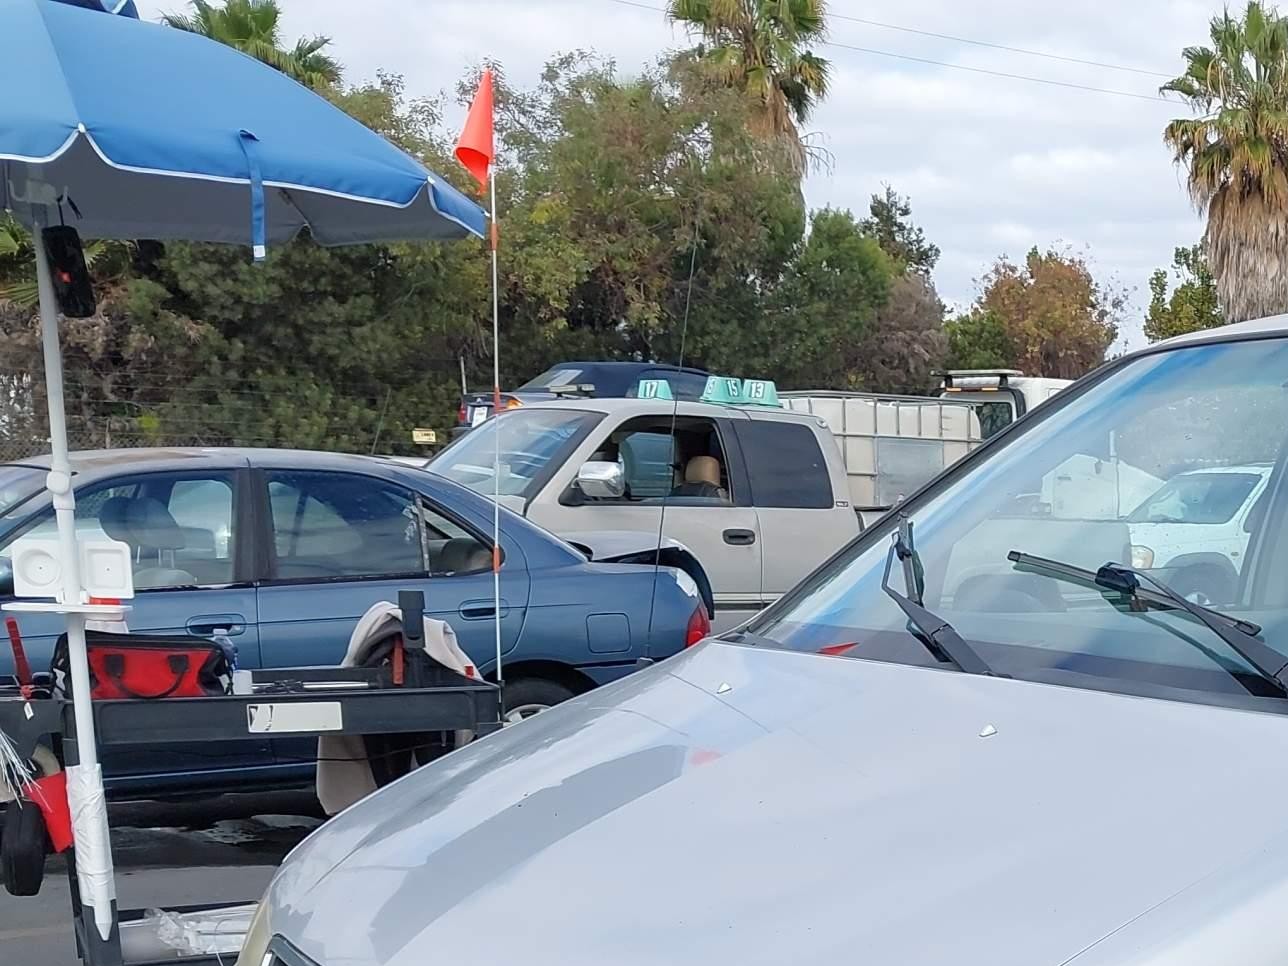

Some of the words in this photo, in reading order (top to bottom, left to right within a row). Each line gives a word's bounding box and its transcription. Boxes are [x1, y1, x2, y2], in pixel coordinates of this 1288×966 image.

[645, 381, 658, 398] 17
[726, 379, 738, 397] 15
[750, 381, 765, 399] 13
